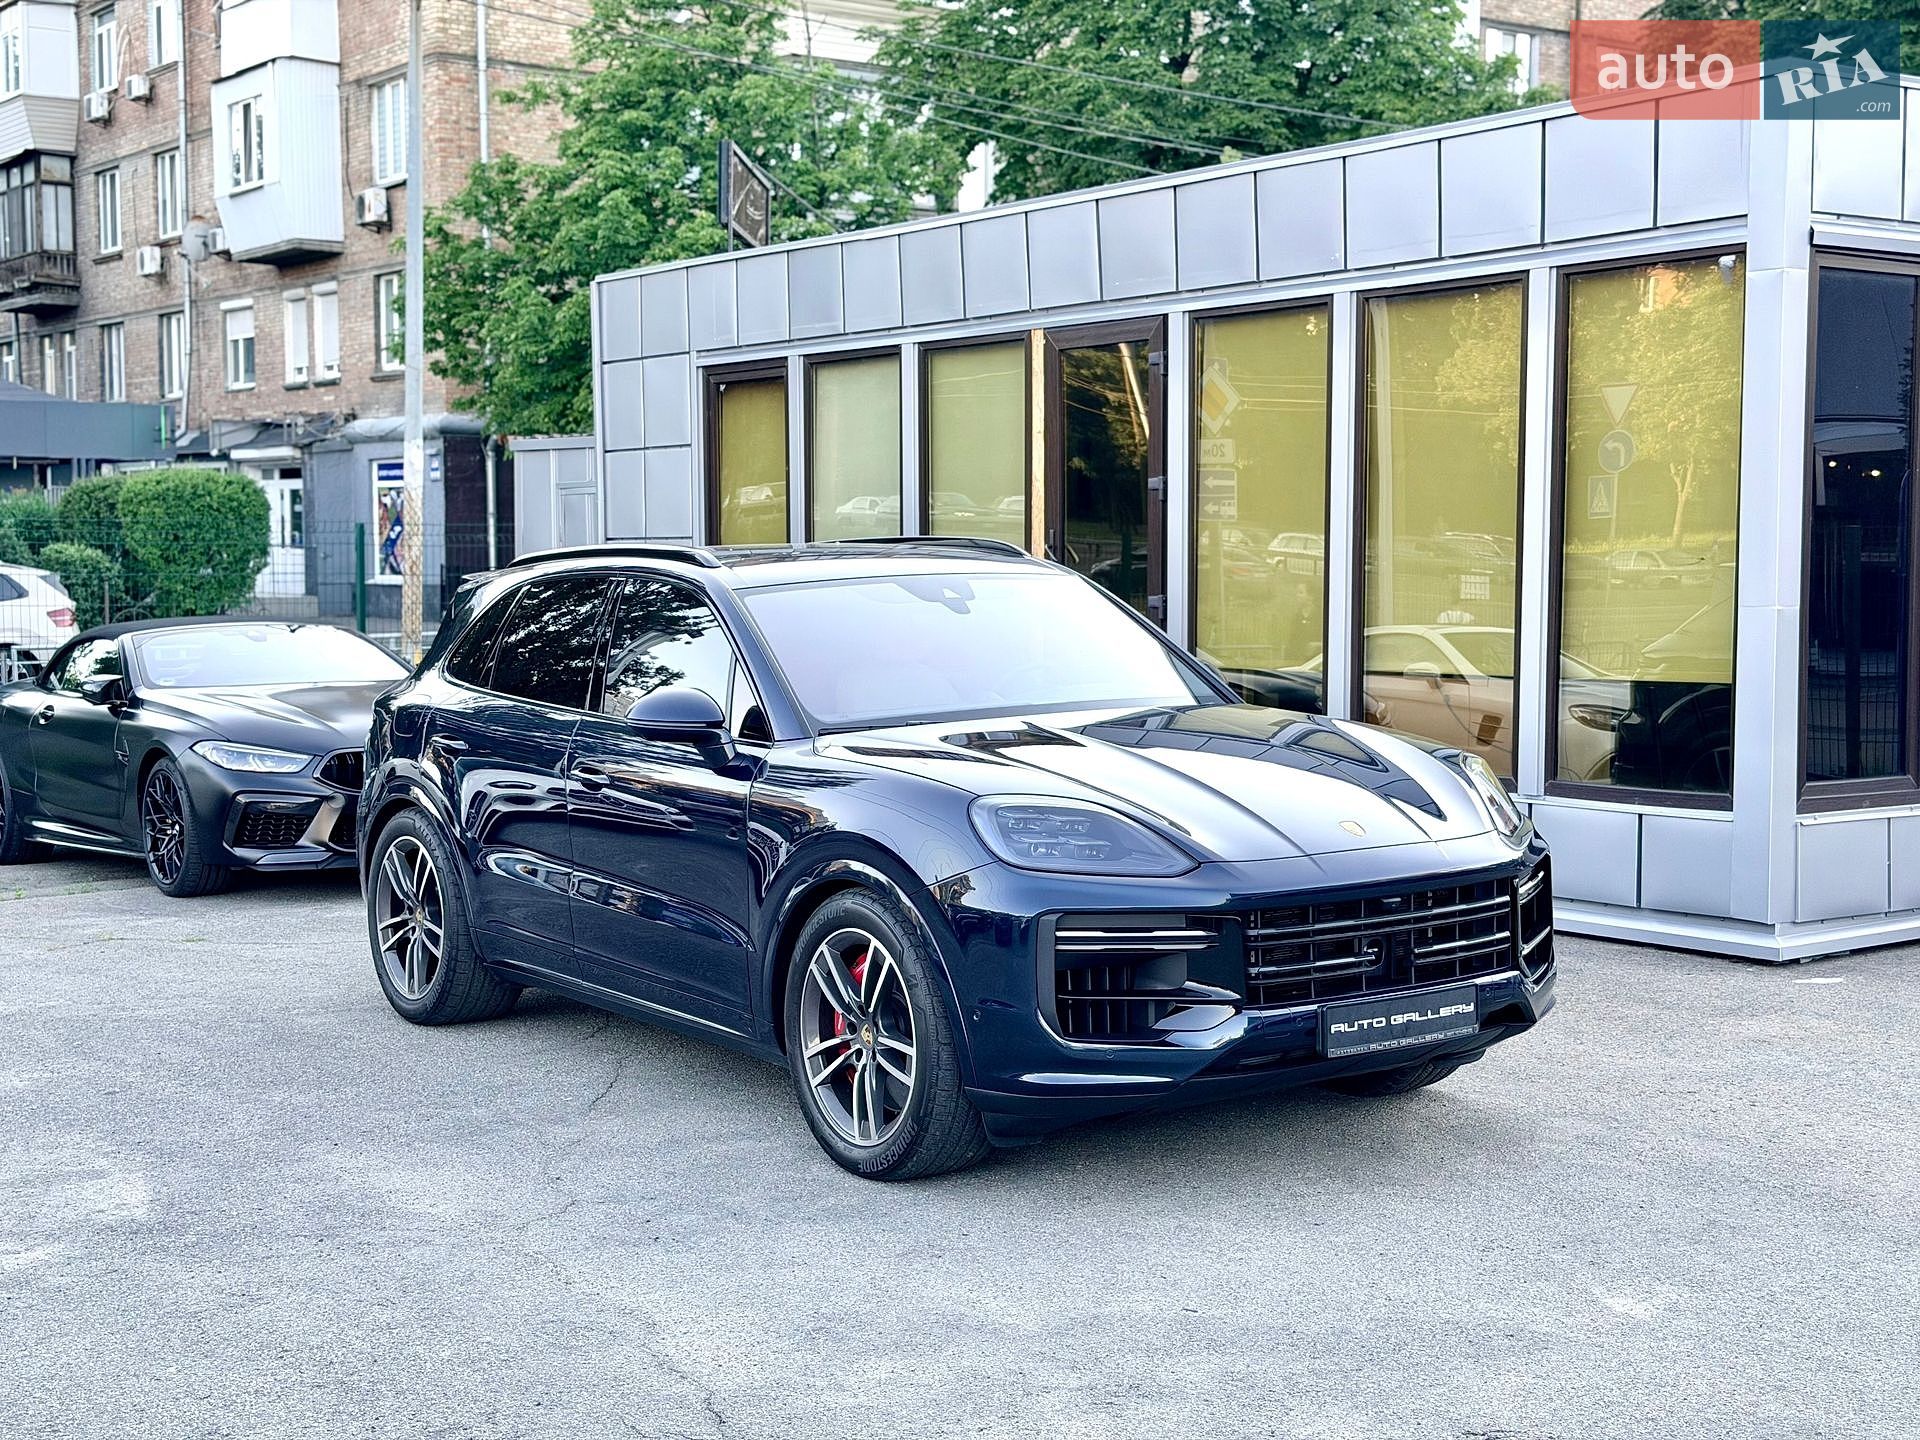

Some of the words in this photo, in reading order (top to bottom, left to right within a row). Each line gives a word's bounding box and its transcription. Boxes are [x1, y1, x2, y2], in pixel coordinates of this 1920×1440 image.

[1330, 1017, 1387, 1034] AUTO
[1390, 1002, 1475, 1025] GALLERY
[1369, 1040, 1398, 1050] AUTO
[1400, 1033, 1445, 1045] GALLERY
[858, 1116, 918, 1172] BRIDGESTONE
